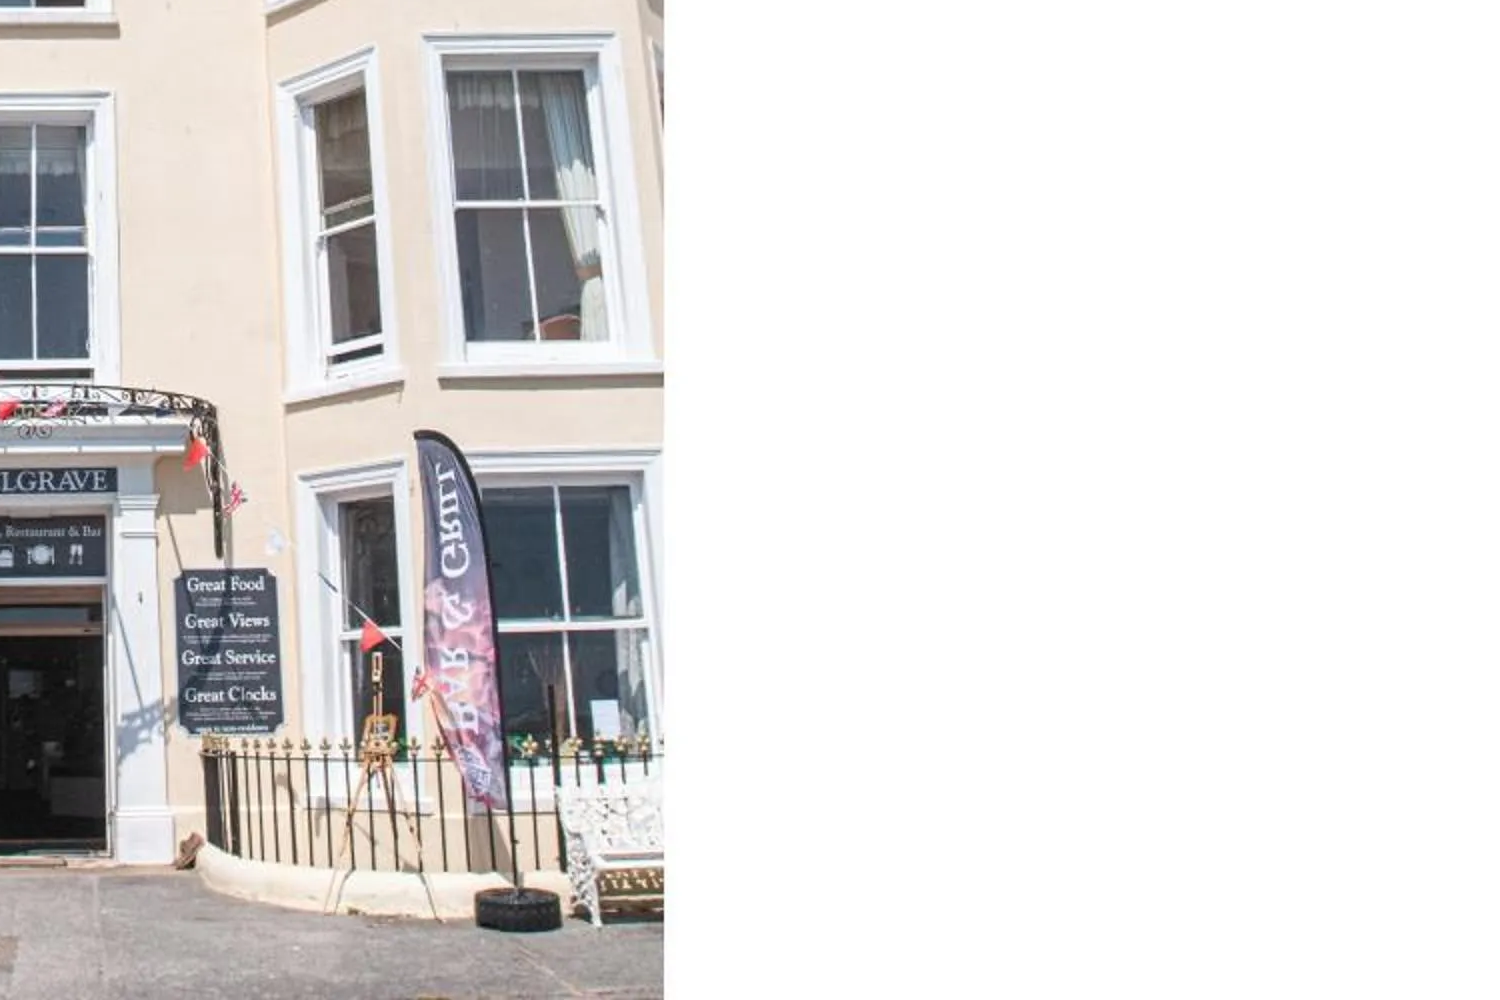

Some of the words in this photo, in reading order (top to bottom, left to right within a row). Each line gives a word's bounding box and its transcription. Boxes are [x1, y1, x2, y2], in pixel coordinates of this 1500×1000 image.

[6, 525, 65, 537] Restaurant
[83, 525, 101, 537] Bar
[187, 577, 226, 592] Great
[231, 576, 265, 591] Food
[185, 613, 224, 629] Great
[228, 613, 270, 628] Views
[181, 649, 222, 665] Great
[225, 649, 277, 665] Service
[185, 687, 225, 703] Great
[227, 685, 277, 702] Clocks
